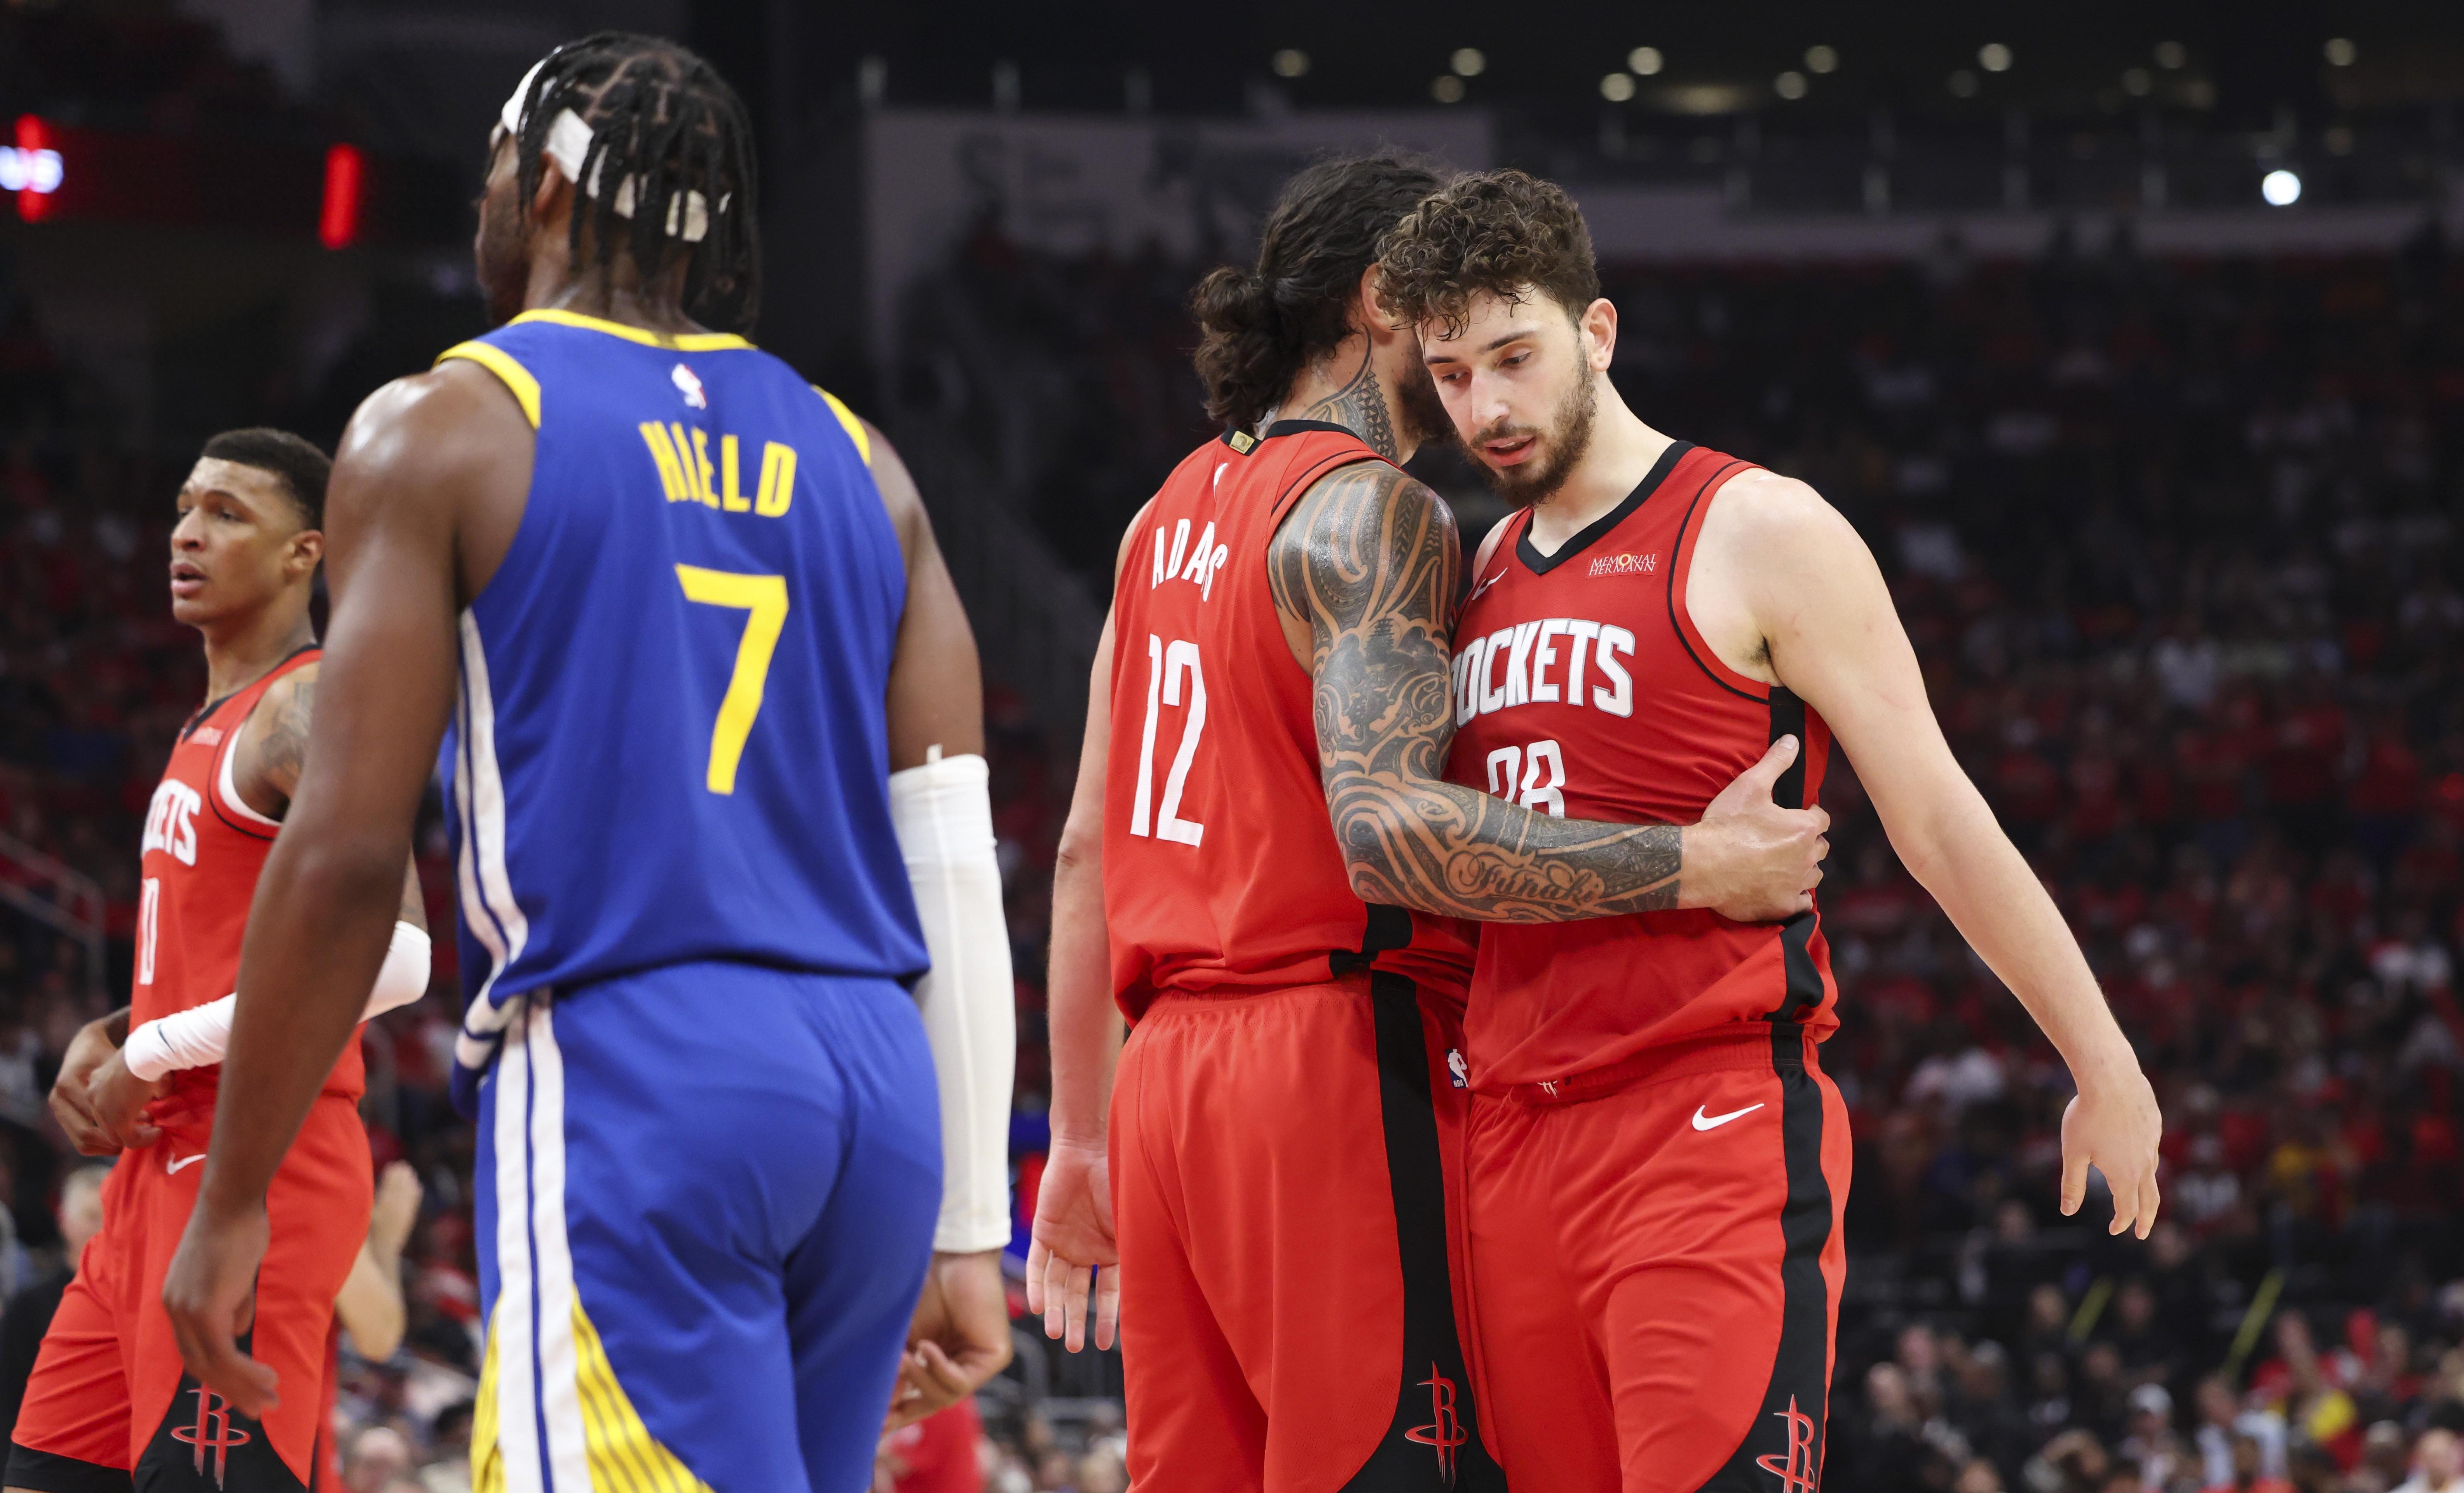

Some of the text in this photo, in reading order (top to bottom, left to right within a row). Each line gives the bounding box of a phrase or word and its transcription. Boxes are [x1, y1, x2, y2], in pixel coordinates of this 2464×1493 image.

[639, 420, 797, 518] HIELD
[1152, 518, 1228, 602] ADAS
[1588, 562, 1656, 576] HERMANN
[1591, 554, 1657, 566] MEMORIAL
[675, 563, 790, 795] 7
[1130, 633, 1207, 848] 12
[1453, 1079, 1464, 1088] NBA
